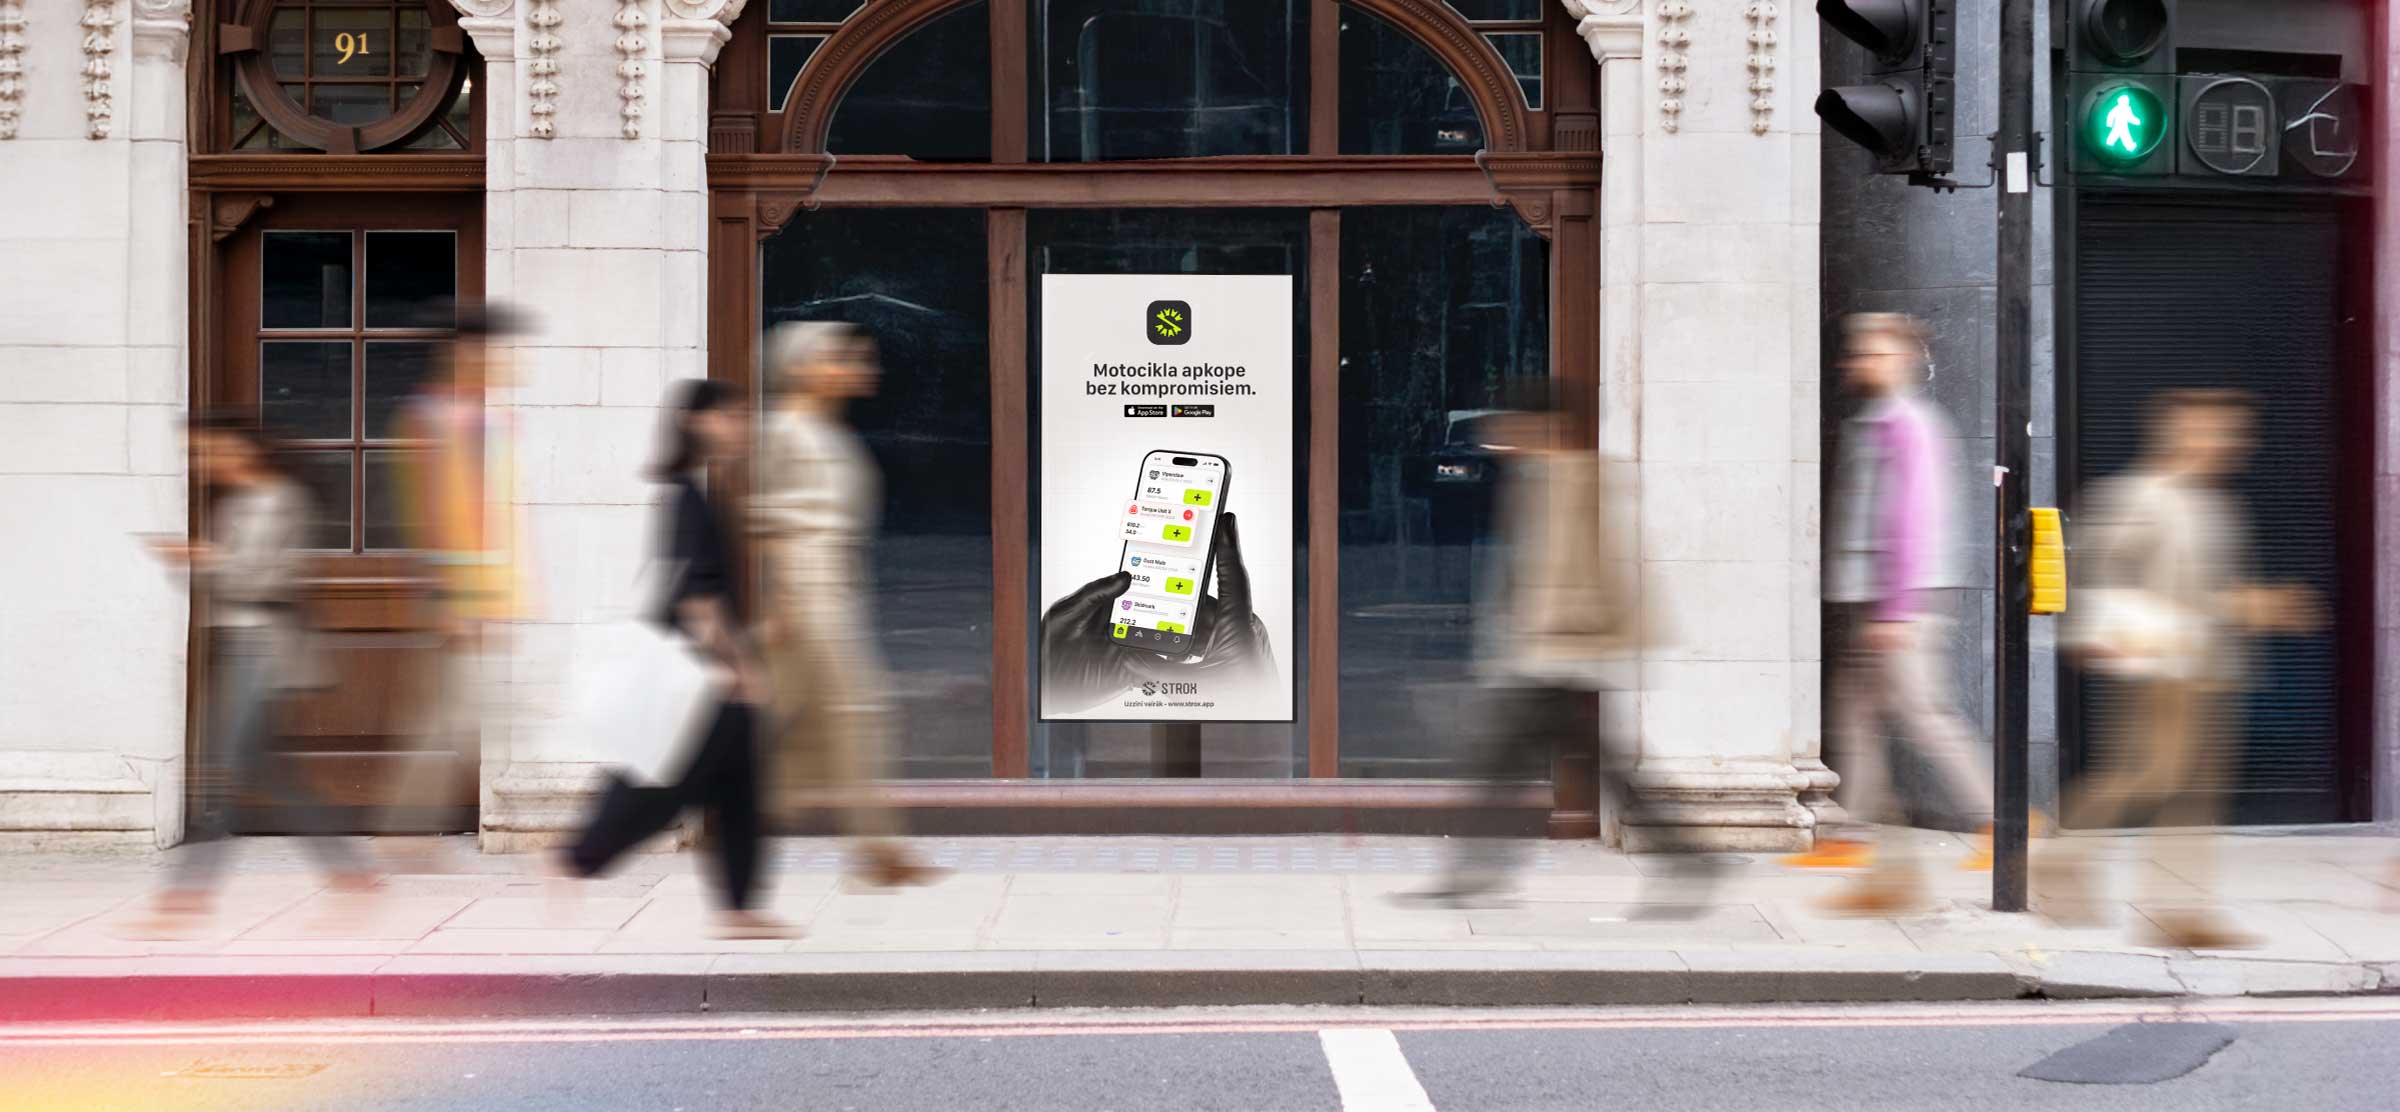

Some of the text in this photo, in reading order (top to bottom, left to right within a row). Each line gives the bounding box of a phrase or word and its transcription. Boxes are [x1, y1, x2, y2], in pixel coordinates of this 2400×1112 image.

[335, 32, 370, 64] 91
[1093, 362, 1246, 380] Motocikla apkope
[1086, 380, 1257, 398] bez kompromisiem.
